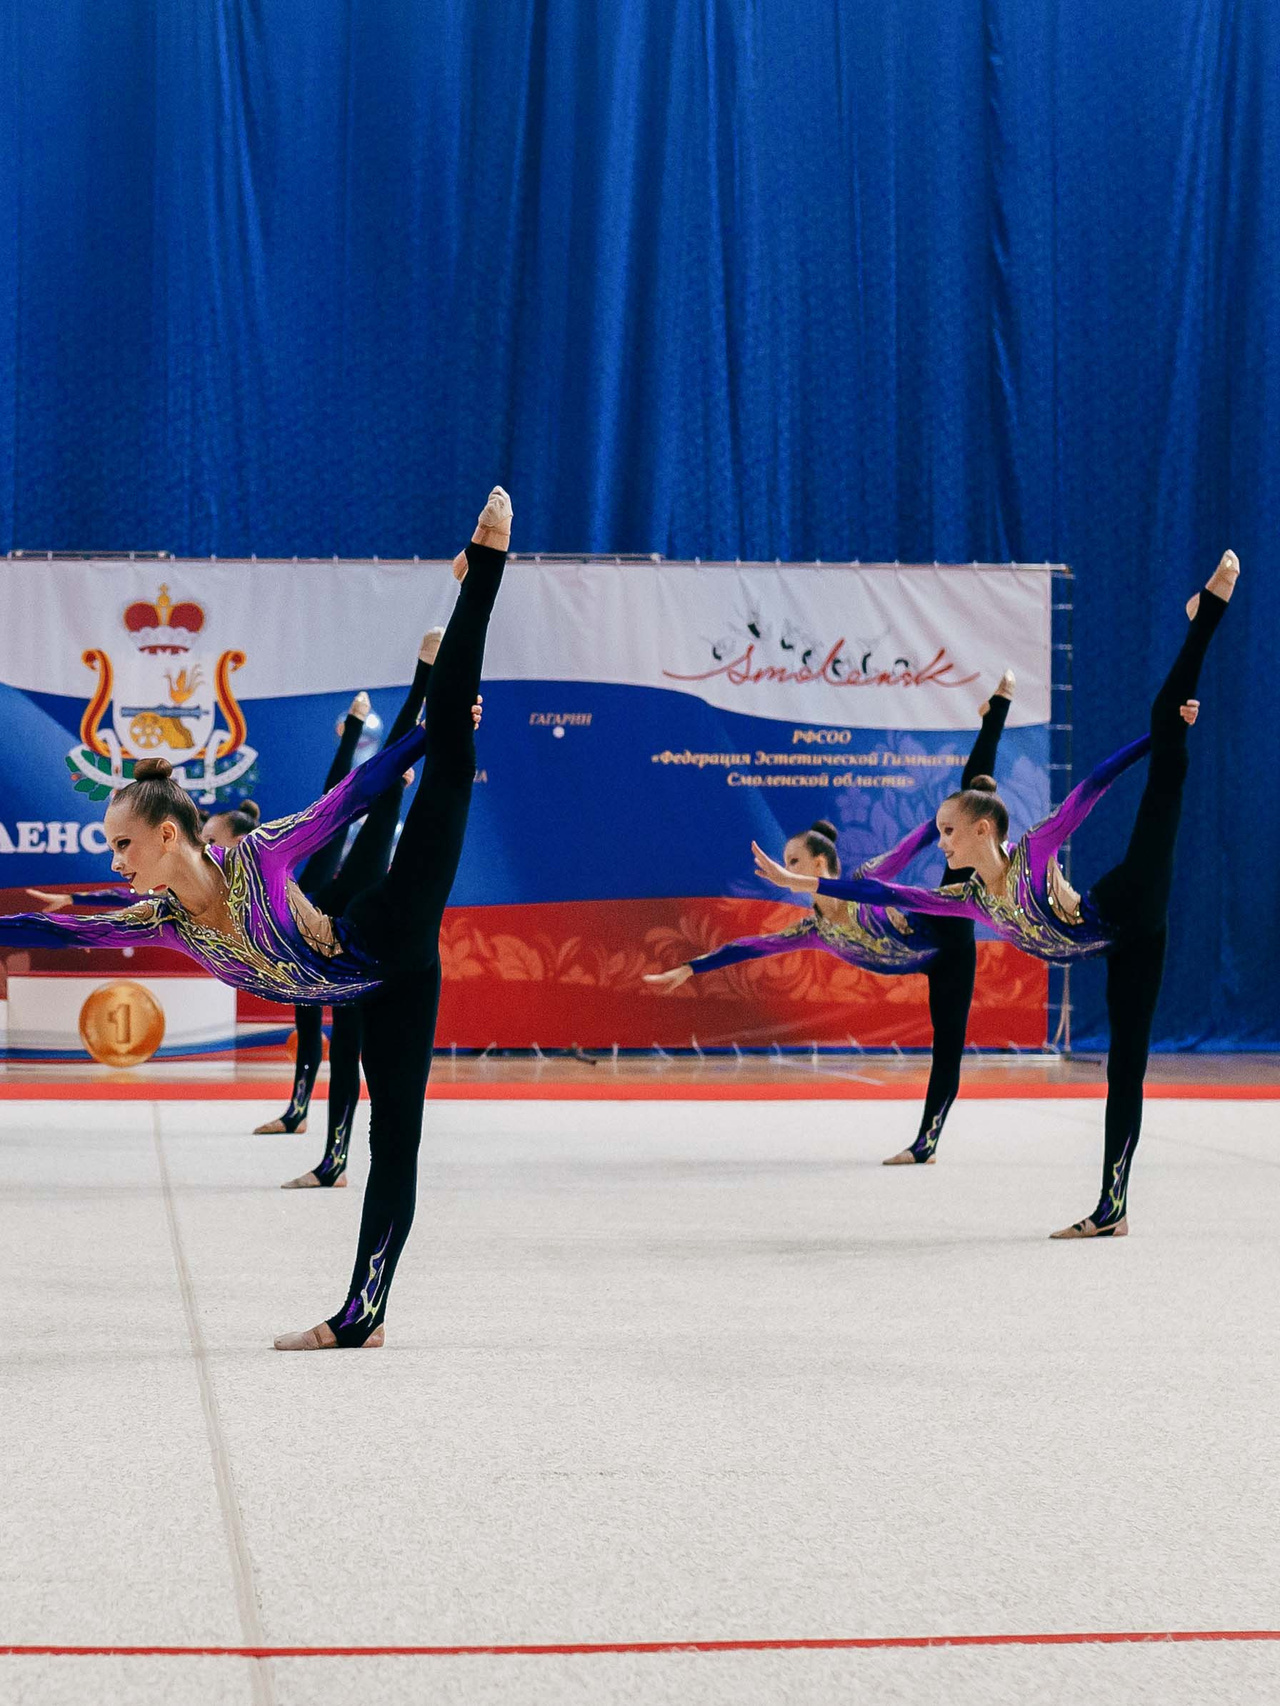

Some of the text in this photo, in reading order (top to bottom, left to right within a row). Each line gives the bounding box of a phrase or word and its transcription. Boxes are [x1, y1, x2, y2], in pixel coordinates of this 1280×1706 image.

[529, 713, 593, 726] ГАГАРИН
[793, 729, 852, 744] РФСОО
[882, 751, 969, 766] Гимнасти
[727, 771, 829, 787] Смоленской
